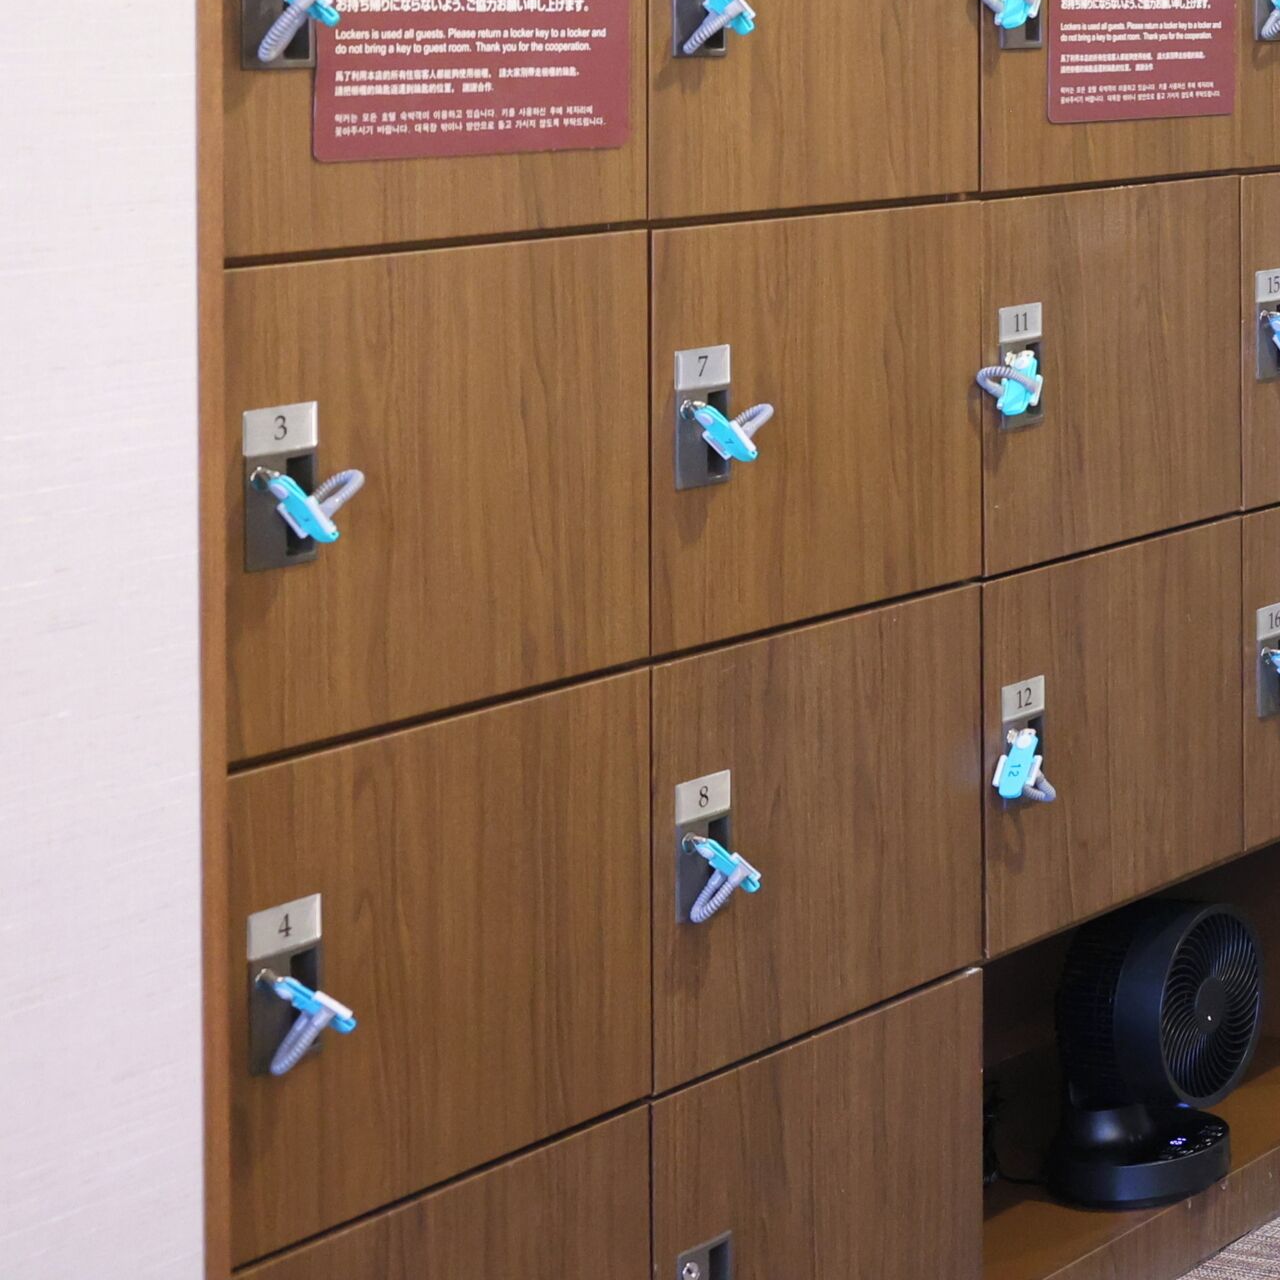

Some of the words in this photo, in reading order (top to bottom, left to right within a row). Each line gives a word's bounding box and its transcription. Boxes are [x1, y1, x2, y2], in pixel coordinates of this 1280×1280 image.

[335, 28, 370, 40] Lockers
[371, 28, 379, 39] is
[381, 28, 402, 39] used
[404, 28, 414, 39] all
[415, 28, 446, 41] guests.
[448, 28, 476, 39] Please
[477, 28, 501, 38] return
[510, 28, 534, 38] locker
[535, 28, 549, 40] key
[551, 28, 559, 38] to
[567, 28, 590, 38] locker
[591, 28, 606, 38] and
[335, 43, 347, 54] do
[348, 43, 363, 54] not
[364, 43, 387, 56] bring
[396, 43, 411, 55] key
[413, 43, 422, 53] to
[423, 43, 446, 56] guest
[475, 41, 500, 52] Thank
[502, 42, 517, 54] you
[518, 41, 529, 52] for
[531, 41, 543, 52] the
[544, 41, 591, 53] cooperation.
[1268, 276, 1280, 294] 15
[1014, 312, 1028, 333] 11
[698, 355, 708, 376] 7
[274, 415, 287, 440] 3
[1268, 610, 1280, 629] 16
[1017, 687, 1033, 709] 12
[699, 786, 708, 808] 8
[277, 914, 292, 938] 4
